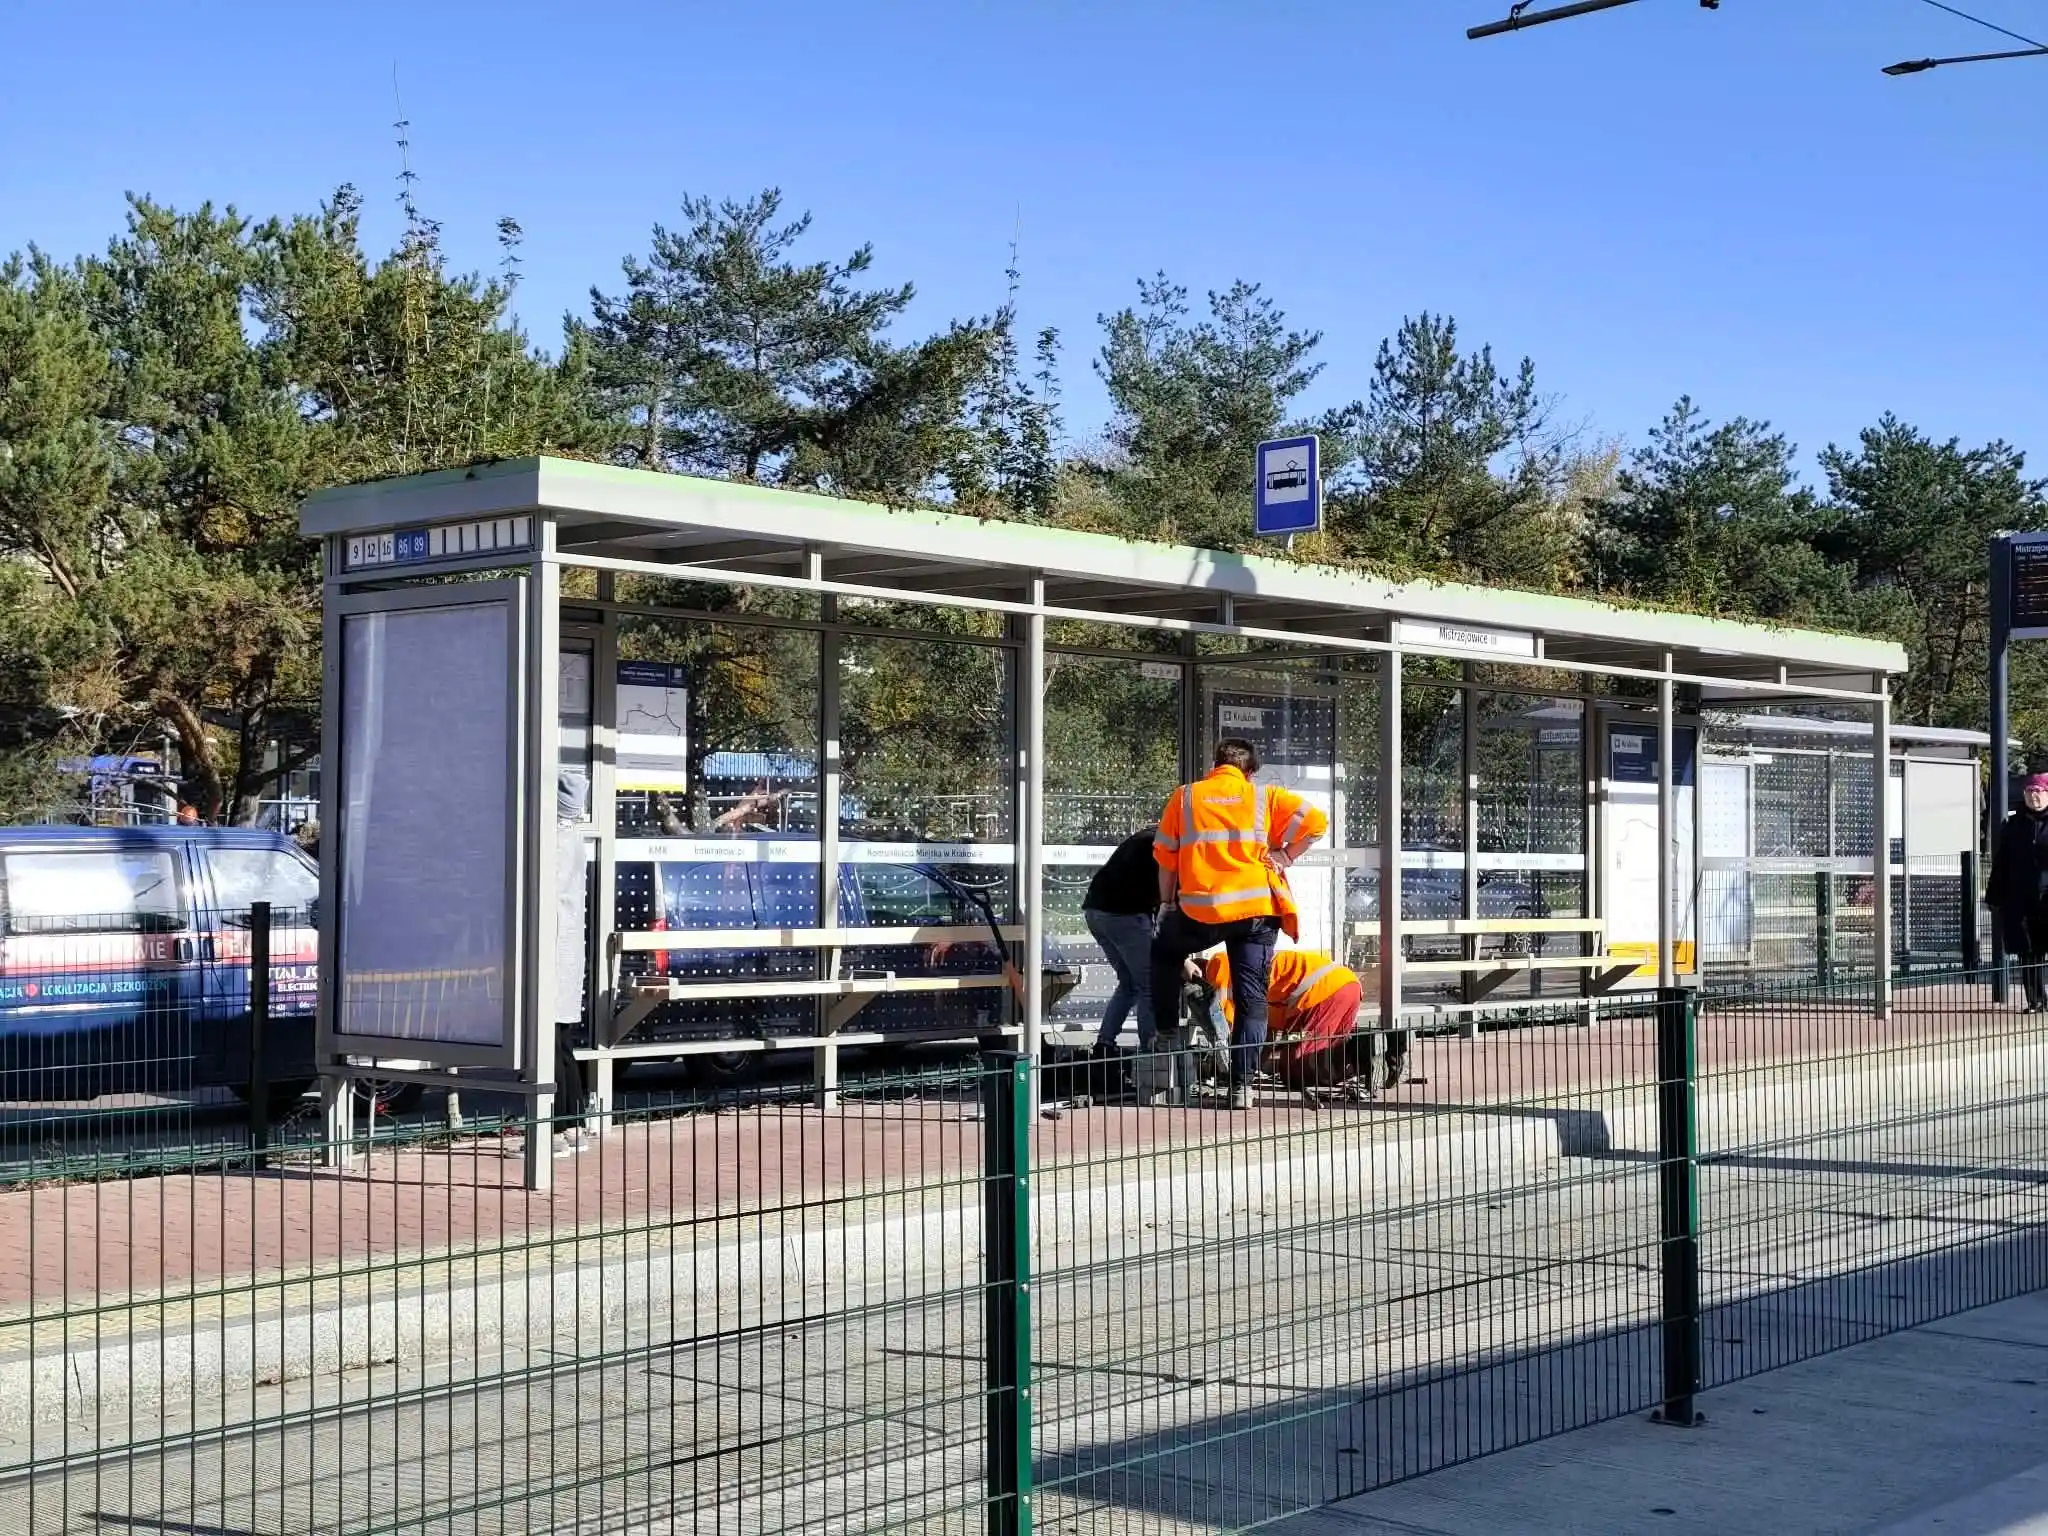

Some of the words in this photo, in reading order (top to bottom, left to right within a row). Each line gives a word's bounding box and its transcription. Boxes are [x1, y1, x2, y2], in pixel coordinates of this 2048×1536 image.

[353, 545, 359, 559] 9
[367, 544, 376, 558] 12
[382, 541, 392, 556] 16
[414, 536, 424, 551] 89
[1439, 624, 1488, 645] Mistrzejowice
[42, 982, 107, 996] LOKALIZACJA
